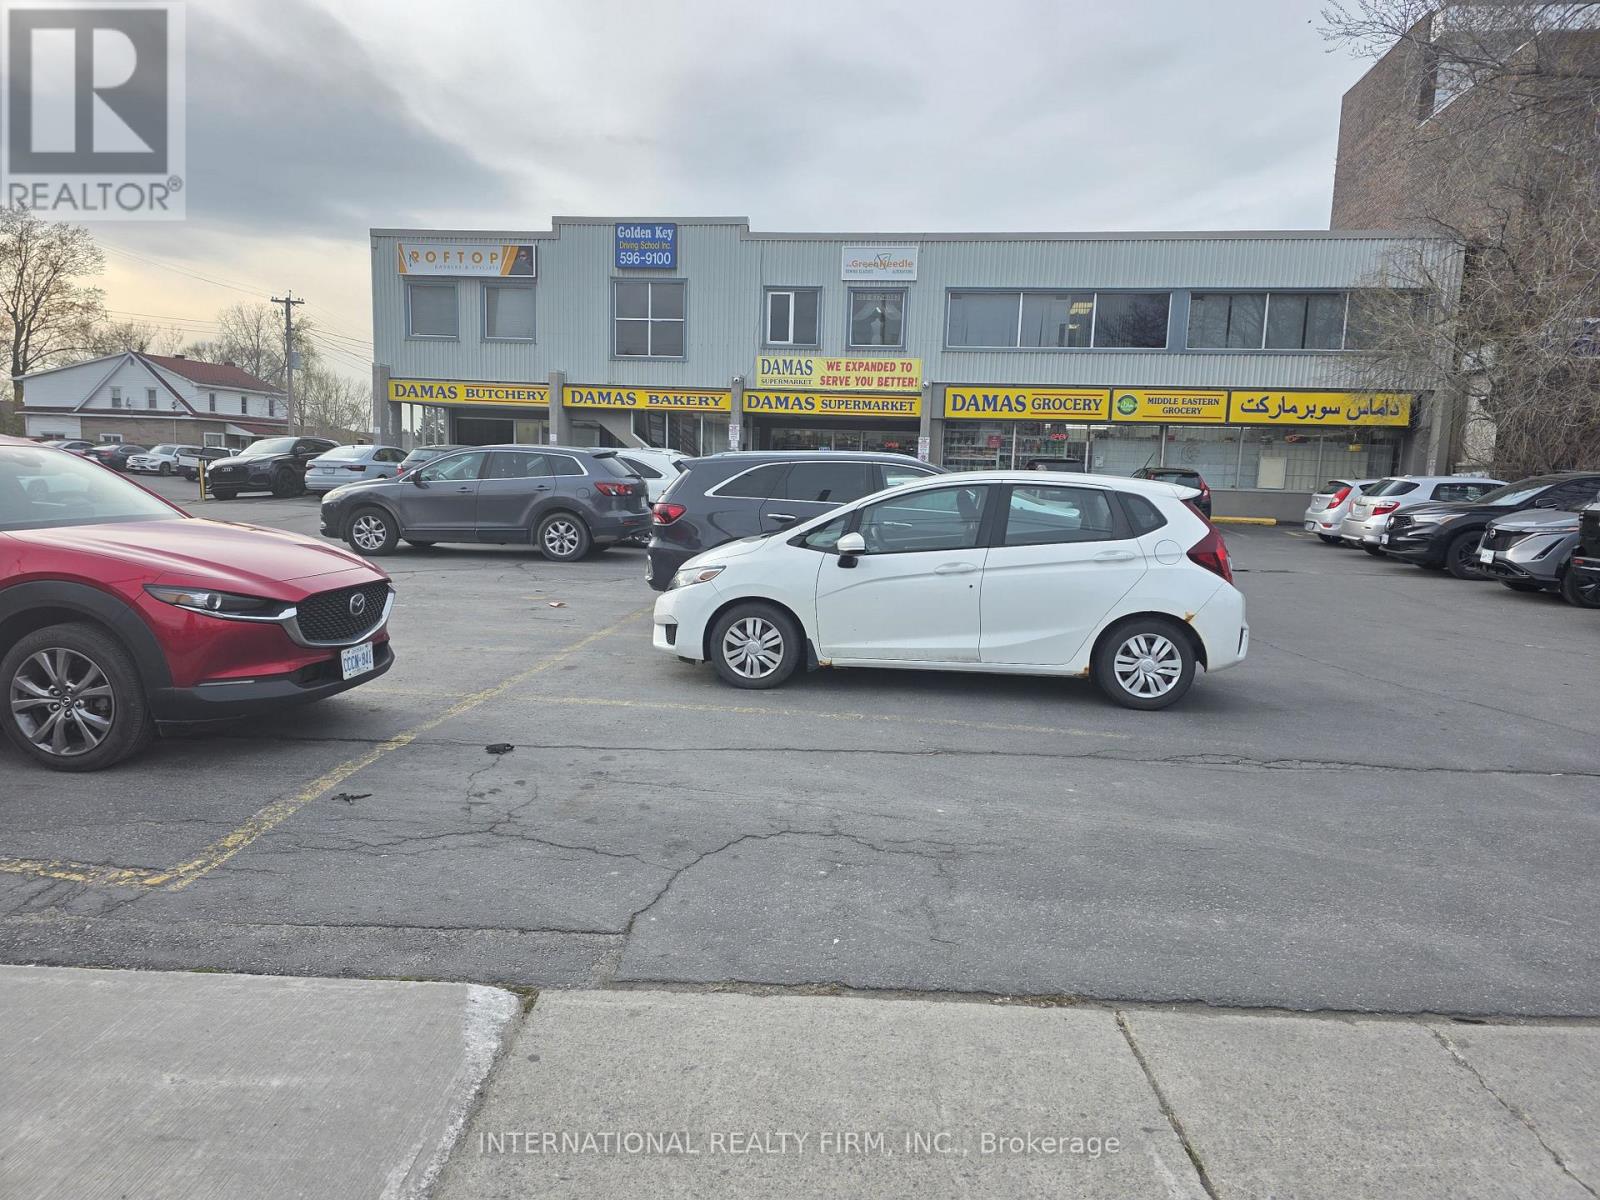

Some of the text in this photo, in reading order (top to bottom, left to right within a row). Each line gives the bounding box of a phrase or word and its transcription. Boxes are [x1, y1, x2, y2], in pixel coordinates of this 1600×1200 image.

[617, 226, 674, 241] Golden Key
[619, 240, 639, 251] Driving
[640, 240, 660, 250] School
[619, 251, 671, 265] 596-9100
[760, 358, 813, 376] DAMAS
[826, 361, 913, 373] WE EXPANDED TO
[761, 378, 813, 386] SUPERMARKET
[819, 375, 918, 388] SERVE YOU BETTER!
[394, 383, 548, 401] DAMAS BUTCHERY
[570, 390, 723, 407] DAMAS BAKERY
[746, 394, 916, 412] DAMAS SUPERMARKET
[951, 393, 1103, 413] DAMAS GROCERY
[1147, 396, 1220, 406] MIDDLE EASTERN
[1162, 406, 1203, 415] GROCERY
